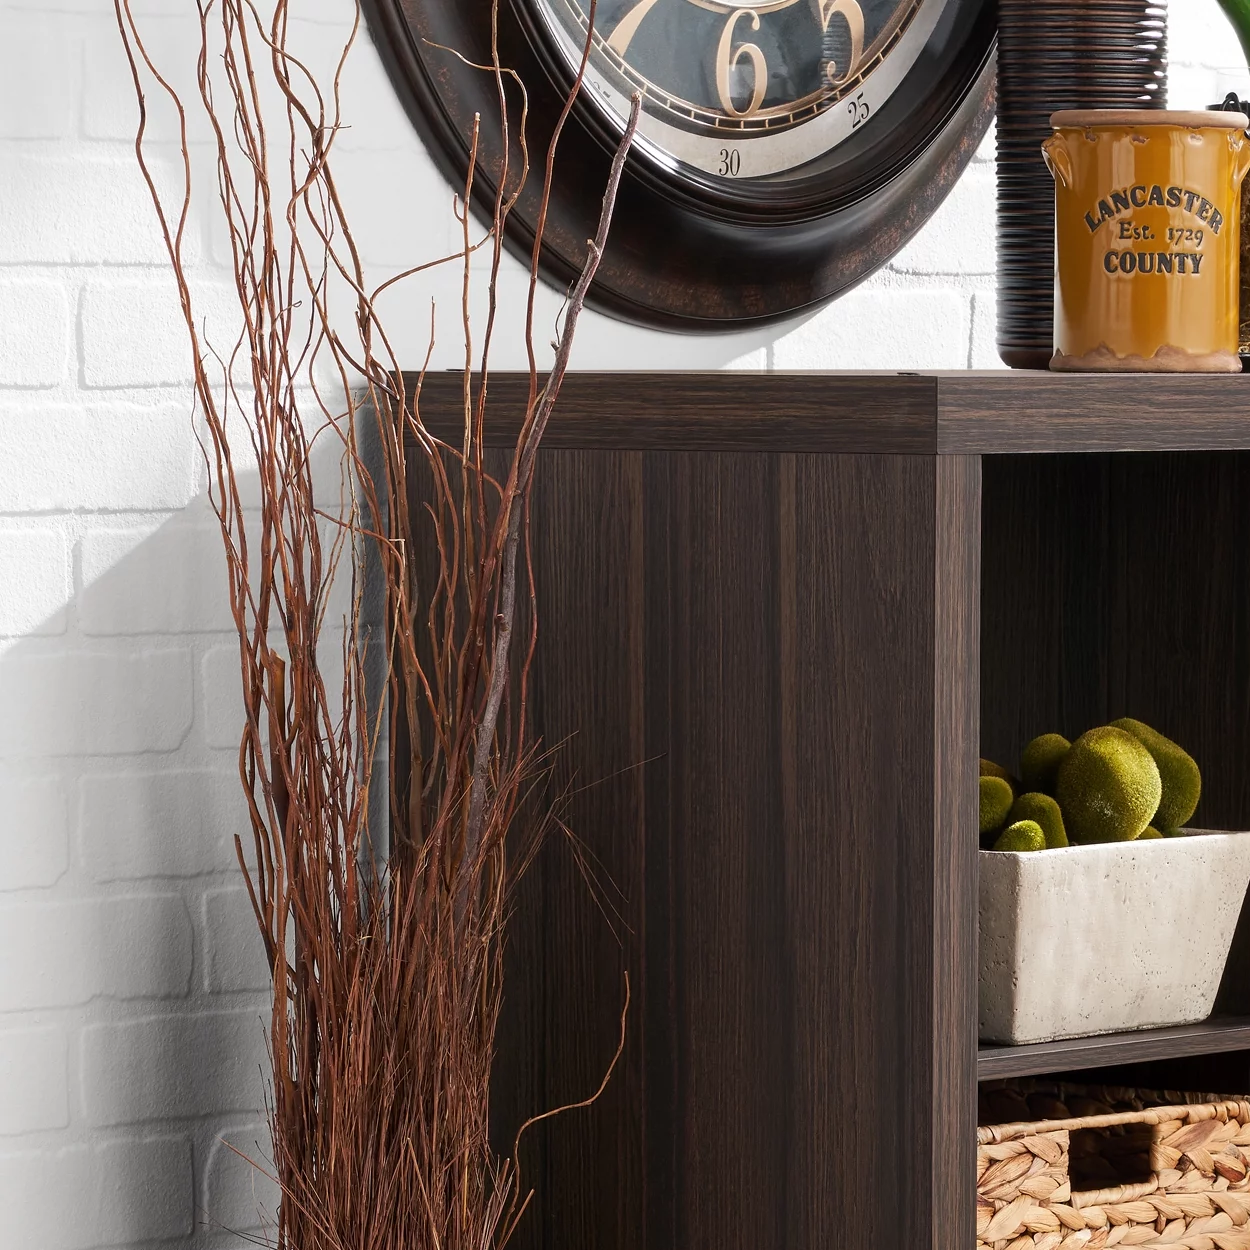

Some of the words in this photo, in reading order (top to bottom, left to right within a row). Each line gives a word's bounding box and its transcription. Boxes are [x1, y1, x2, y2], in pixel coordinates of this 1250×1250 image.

[716, 8, 768, 117] 6
[847, 92, 870, 129] 25
[718, 148, 741, 177] 30
[1084, 185, 1223, 235] LANCASTER
[1118, 221, 1155, 240] Est.
[1168, 228, 1204, 247] 1729
[1104, 251, 1204, 274] COUNTY
